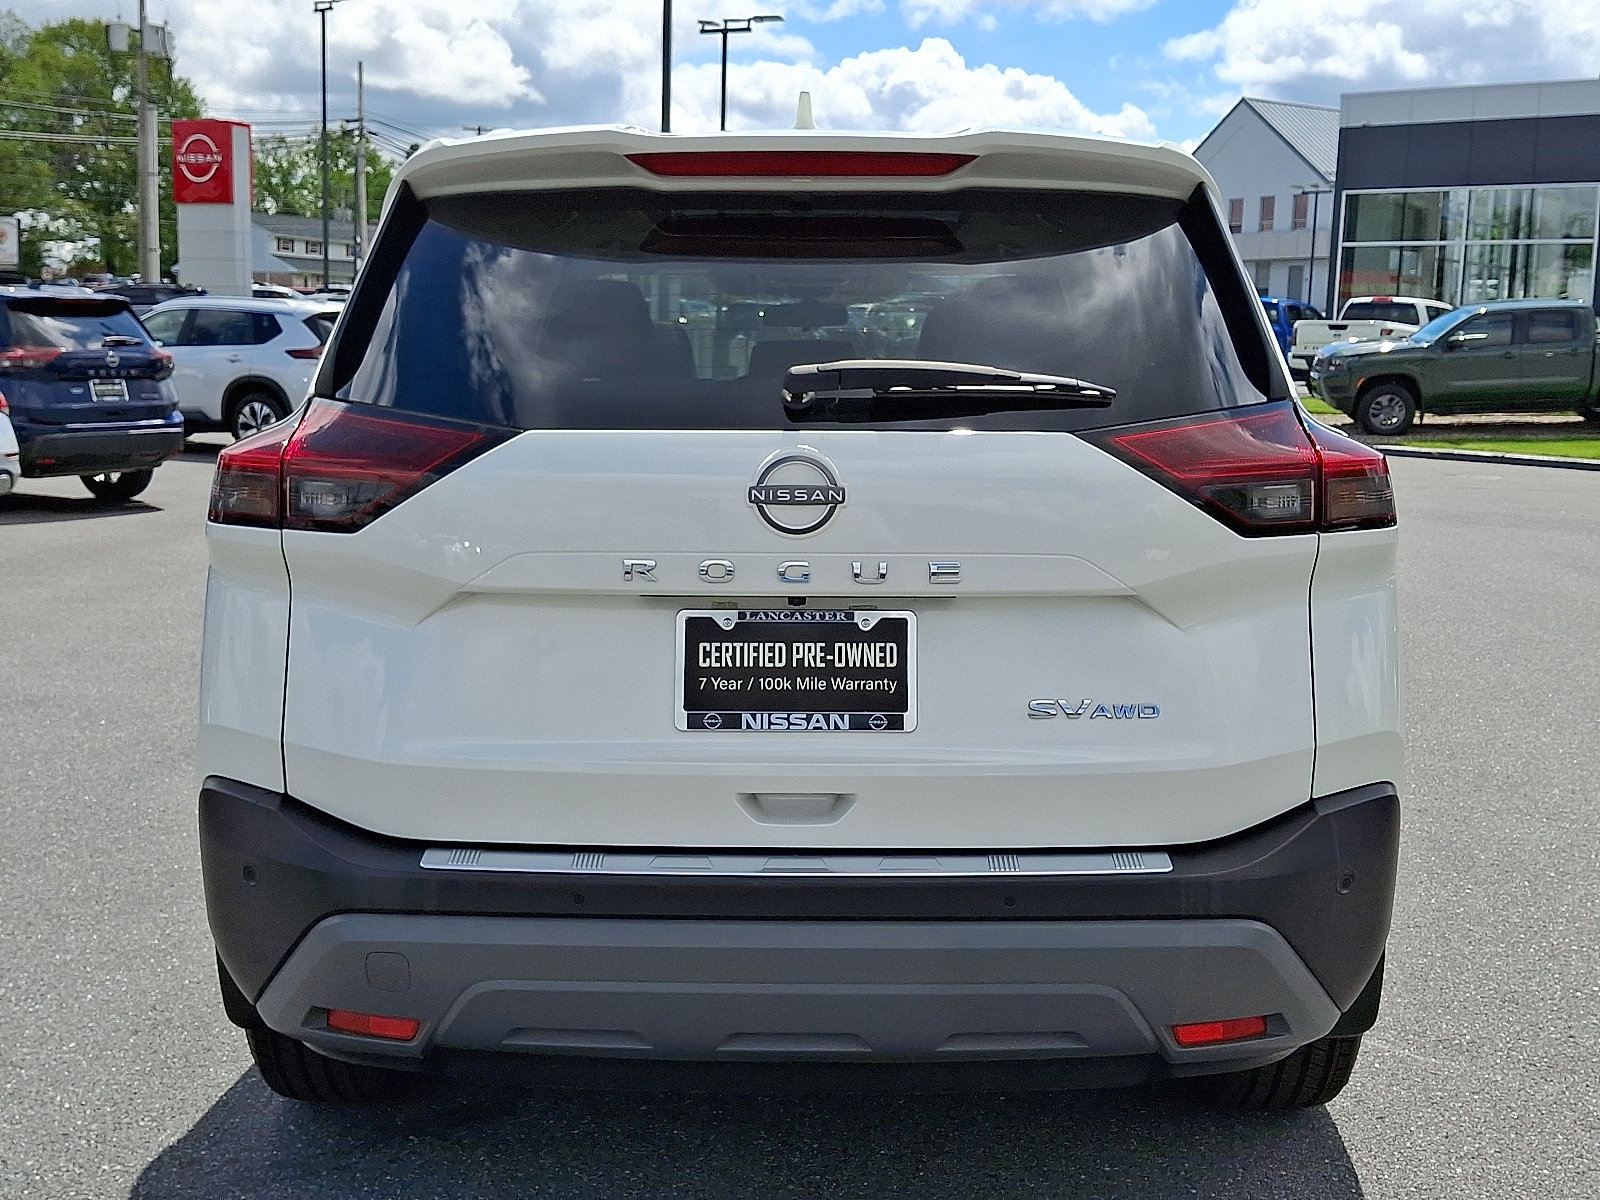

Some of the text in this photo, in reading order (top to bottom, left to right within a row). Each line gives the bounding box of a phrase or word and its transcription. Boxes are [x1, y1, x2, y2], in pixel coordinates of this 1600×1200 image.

[751, 489, 844, 501] NISSAN
[623, 559, 962, 584] ROGUE
[745, 611, 847, 621] LANCASTER
[698, 642, 898, 668] CERTIFIED PRE-OWNED
[699, 677, 897, 694] 7 Year / 100k Mile Warranty
[741, 713, 849, 730] NISSAN
